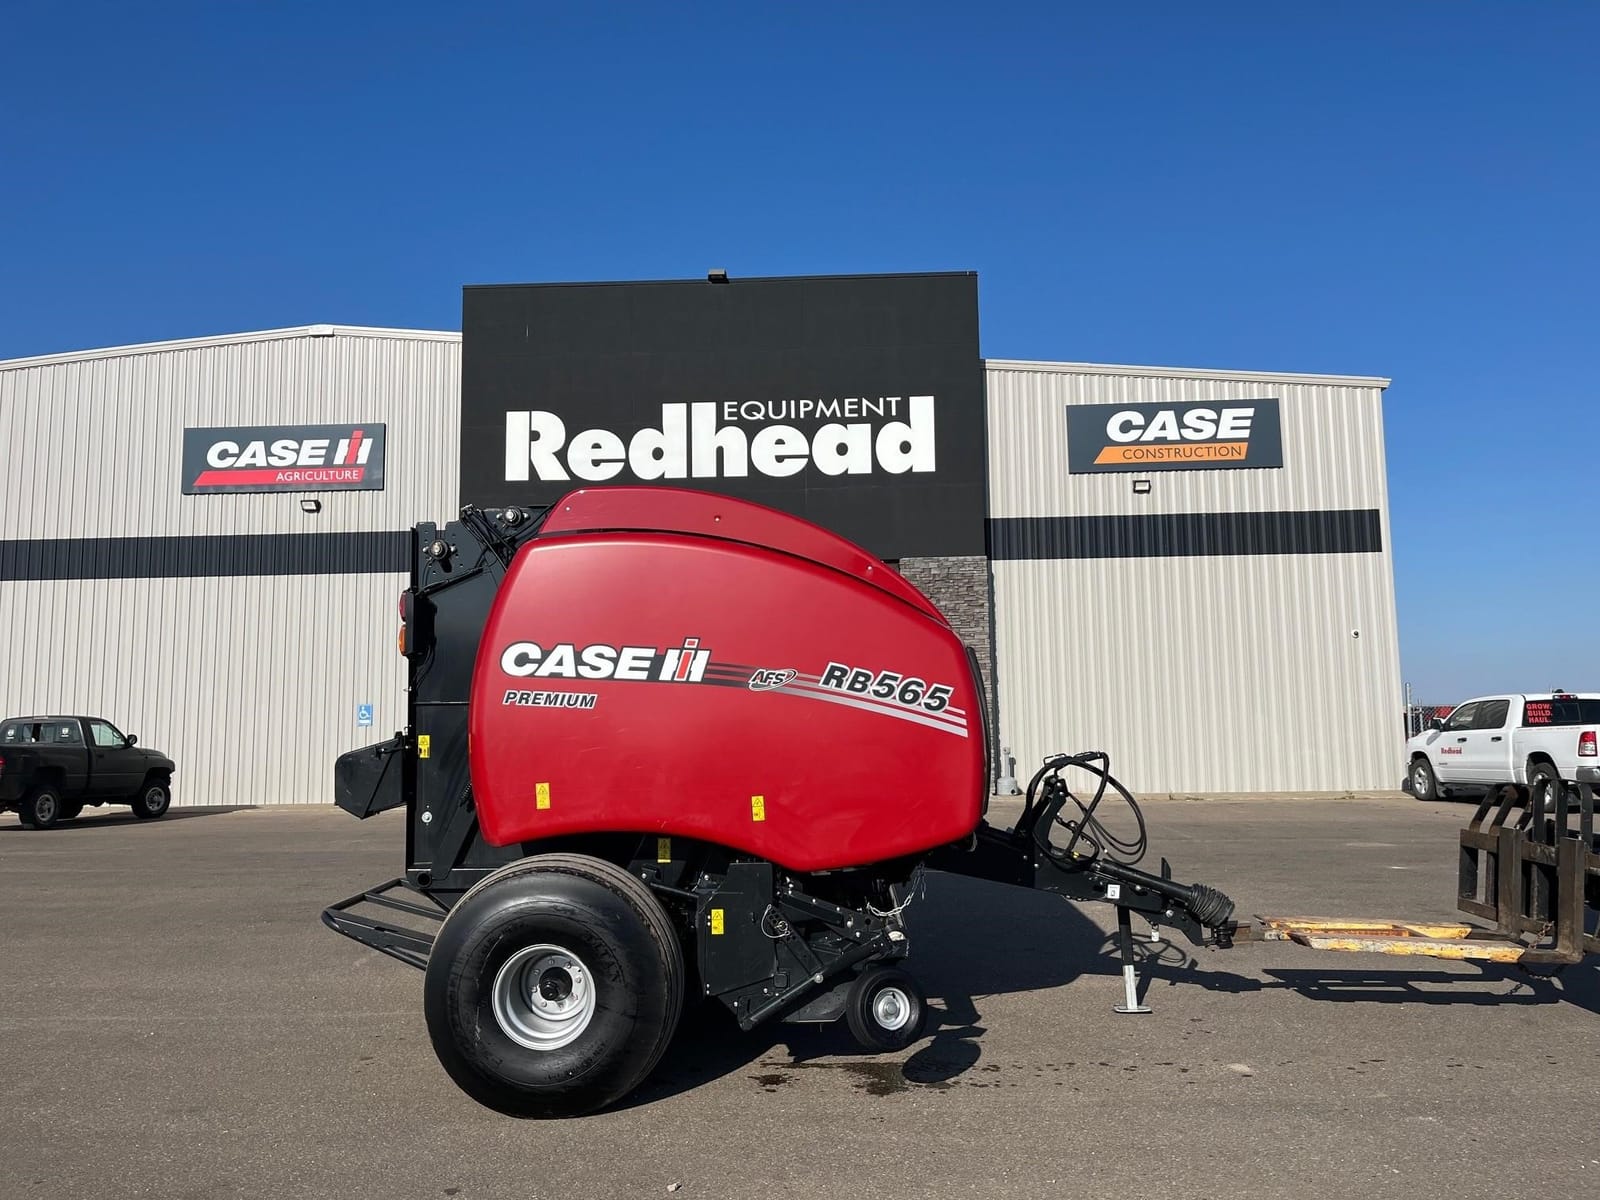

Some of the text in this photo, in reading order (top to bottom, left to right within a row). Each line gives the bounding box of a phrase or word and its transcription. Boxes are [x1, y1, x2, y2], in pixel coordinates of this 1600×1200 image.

[723, 396, 901, 420] EQUIPMENT
[505, 395, 936, 481] Redhead
[1106, 407, 1255, 443] CASE
[206, 439, 330, 468] CASE
[1122, 445, 1242, 460] CONSTRUCTION
[275, 469, 359, 482] AGRICULTURE
[501, 641, 657, 680] CASE
[750, 669, 787, 685] AFS
[820, 662, 953, 713] RB565
[504, 690, 597, 708] PREMIUM
